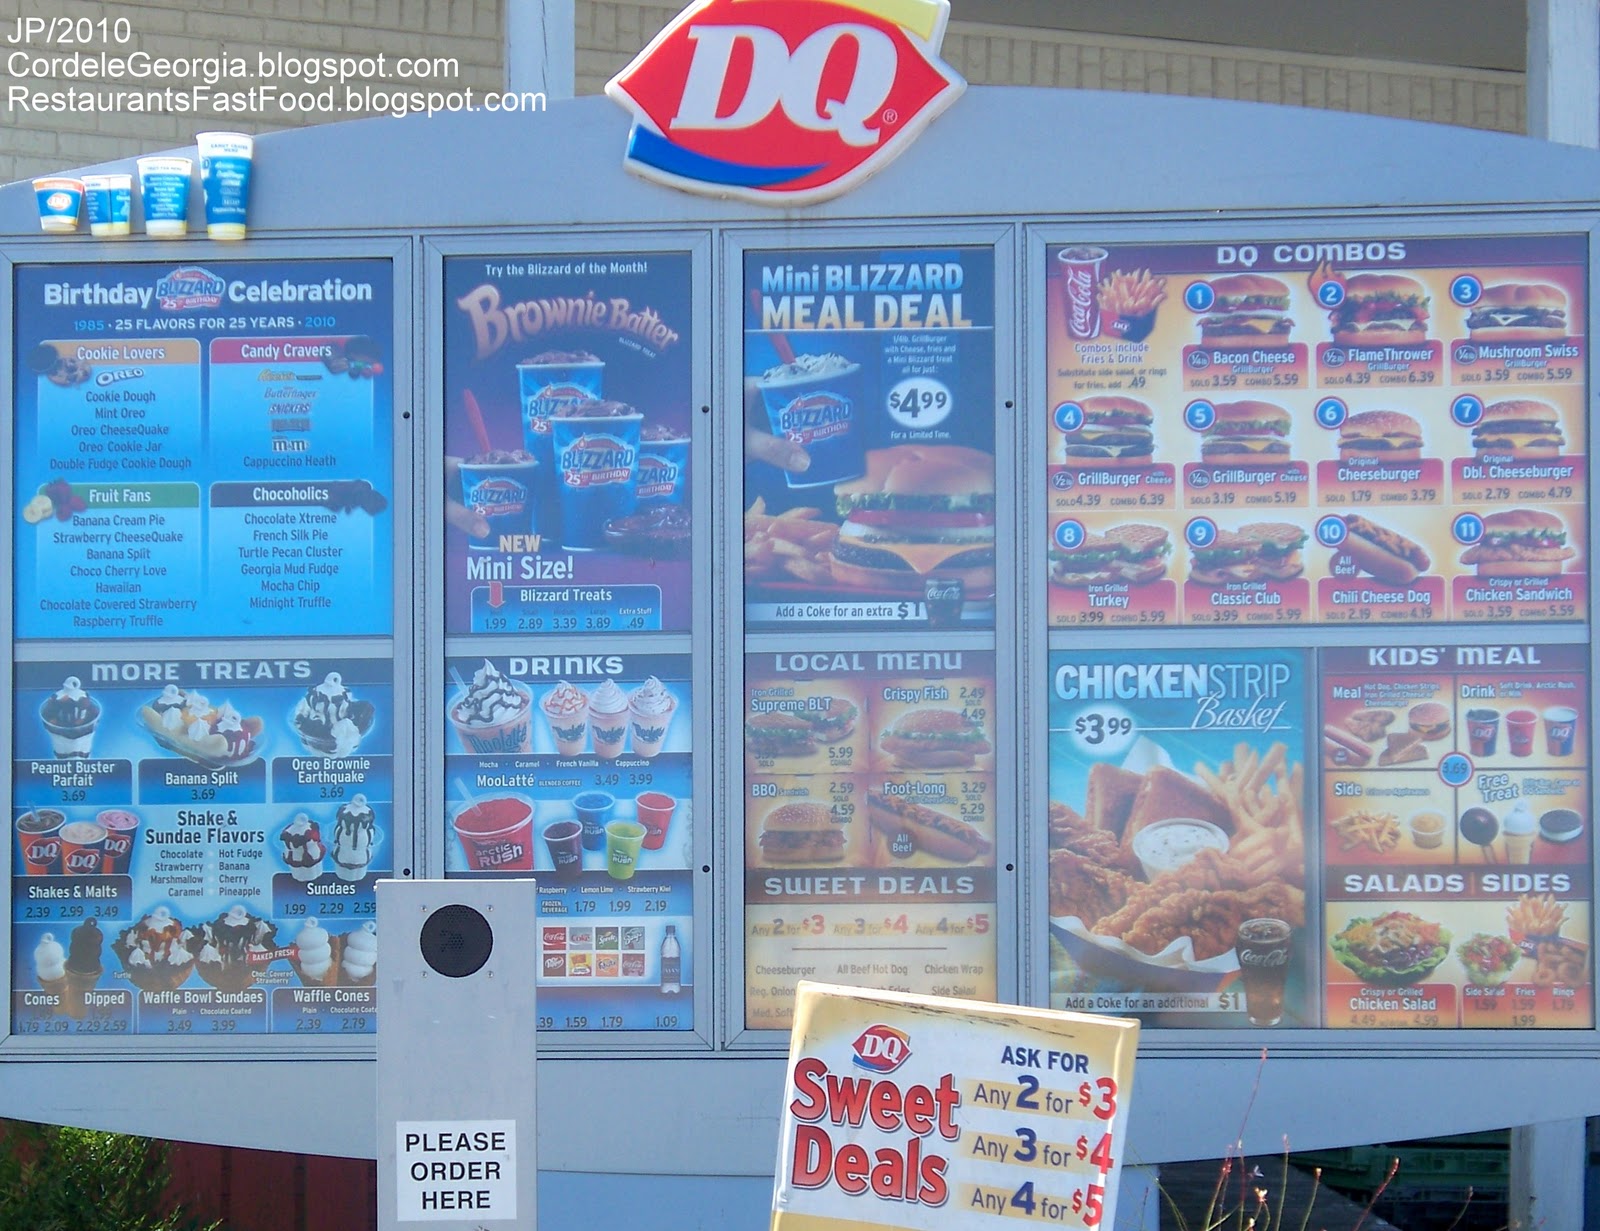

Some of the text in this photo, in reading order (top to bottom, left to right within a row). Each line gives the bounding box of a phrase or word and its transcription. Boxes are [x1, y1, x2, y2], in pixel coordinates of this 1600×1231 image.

[669, 22, 898, 146] DQ
[1217, 246, 1258, 266] DQ
[1273, 242, 1406, 263] COMBOS
[486, 262, 647, 277] Try the Blizzard of the Month!
[762, 263, 964, 292] Mini BLIZZARD
[44, 283, 152, 308] Birthday
[228, 278, 372, 302] Celebration
[762, 293, 972, 330] MEAL DEAL
[74, 315, 336, 331] 1985 25 FLAVORS FOR 25 YEARS 2010
[458, 284, 679, 360] Brownie Batter
[77, 346, 165, 361] Cookie Lovers
[241, 343, 332, 360] Candy Cravers
[1214, 351, 1295, 364] Bacon Cheese
[1349, 349, 1433, 361] FlameThrower
[1479, 344, 1579, 358] Mushroom Swiss
[85, 390, 156, 404] Cookie Dough
[243, 454, 336, 469] Cappuccino Heath
[1078, 472, 1141, 487] GrillBurger
[1338, 468, 1421, 483] Cheeseburger
[1463, 466, 1573, 479] Dbl. Cheeseburger
[89, 487, 151, 503] Fruit Fans
[252, 486, 329, 501] Chocoholics
[500, 535, 541, 552] NEW
[238, 545, 343, 559] Turtle Pecan Cluster
[467, 556, 574, 580] Mini Size!
[520, 589, 612, 601] Blizzard Treats
[1088, 594, 1129, 609] Turkey
[1211, 592, 1281, 605] Classic Club
[1333, 590, 1431, 605] Chili Cheese Dog
[1466, 587, 1572, 602] Chicken Sandwich
[776, 606, 796, 617] Add
[798, 609, 804, 617] a
[806, 606, 831, 617] Coke
[833, 605, 849, 616] for
[851, 607, 863, 616] an
[867, 606, 893, 616] extra
[485, 618, 644, 629] 1.99 2.89 3.39 3.89 .49
[775, 654, 865, 672] LOCAL
[1369, 648, 1446, 665] KIDS'
[196, 661, 311, 680] TREATS
[510, 657, 624, 675] DRINKS
[884, 687, 948, 703] Crispy Fish
[1333, 686, 1361, 698] Meal
[1461, 684, 1496, 697] Drink
[1191, 692, 1287, 733] Basket
[31, 761, 115, 774] Peanut Buster
[292, 758, 370, 771] Oreo Brownie
[52, 774, 93, 787] Parfait
[165, 772, 238, 787] Banana Split
[298, 770, 365, 785] Earthquake
[477, 774, 535, 787] MooLatté
[1478, 775, 1508, 789] Free
[61, 790, 86, 802] 3.69
[191, 789, 215, 800] 3.69
[320, 787, 344, 798] 3.69
[1334, 783, 1362, 796] Side
[1483, 785, 1518, 802] Treat
[177, 812, 238, 826] Shake &
[145, 829, 265, 844] Sundae Flavors
[307, 883, 356, 896] Sundaes
[765, 877, 974, 895] SWEET DEALS
[1344, 874, 1465, 892] SALADS
[1482, 874, 1571, 892] SIDES
[28, 885, 118, 899] Shakes & Malts
[25, 905, 119, 918] 2.39 2.99 3.49
[575, 901, 667, 912] 1.79 1.99 2.19
[143, 990, 263, 1004] Waffle Bowl Sundaes
[1350, 999, 1436, 1011] Chicken Salad
[862, 1035, 901, 1063] DQ
[1001, 1046, 1089, 1074] ASK FOR
[790, 1057, 960, 1141] Sweet
[974, 1075, 1118, 1121] Any 2 for $3
[406, 1132, 506, 1152] PLEASE
[973, 1128, 1115, 1174] Any 3 for $4
[411, 1162, 501, 1181] ORDER
[791, 1124, 949, 1206] Deals
[422, 1190, 491, 1210] HERE
[971, 1181, 1104, 1227] Any 4 for $5
